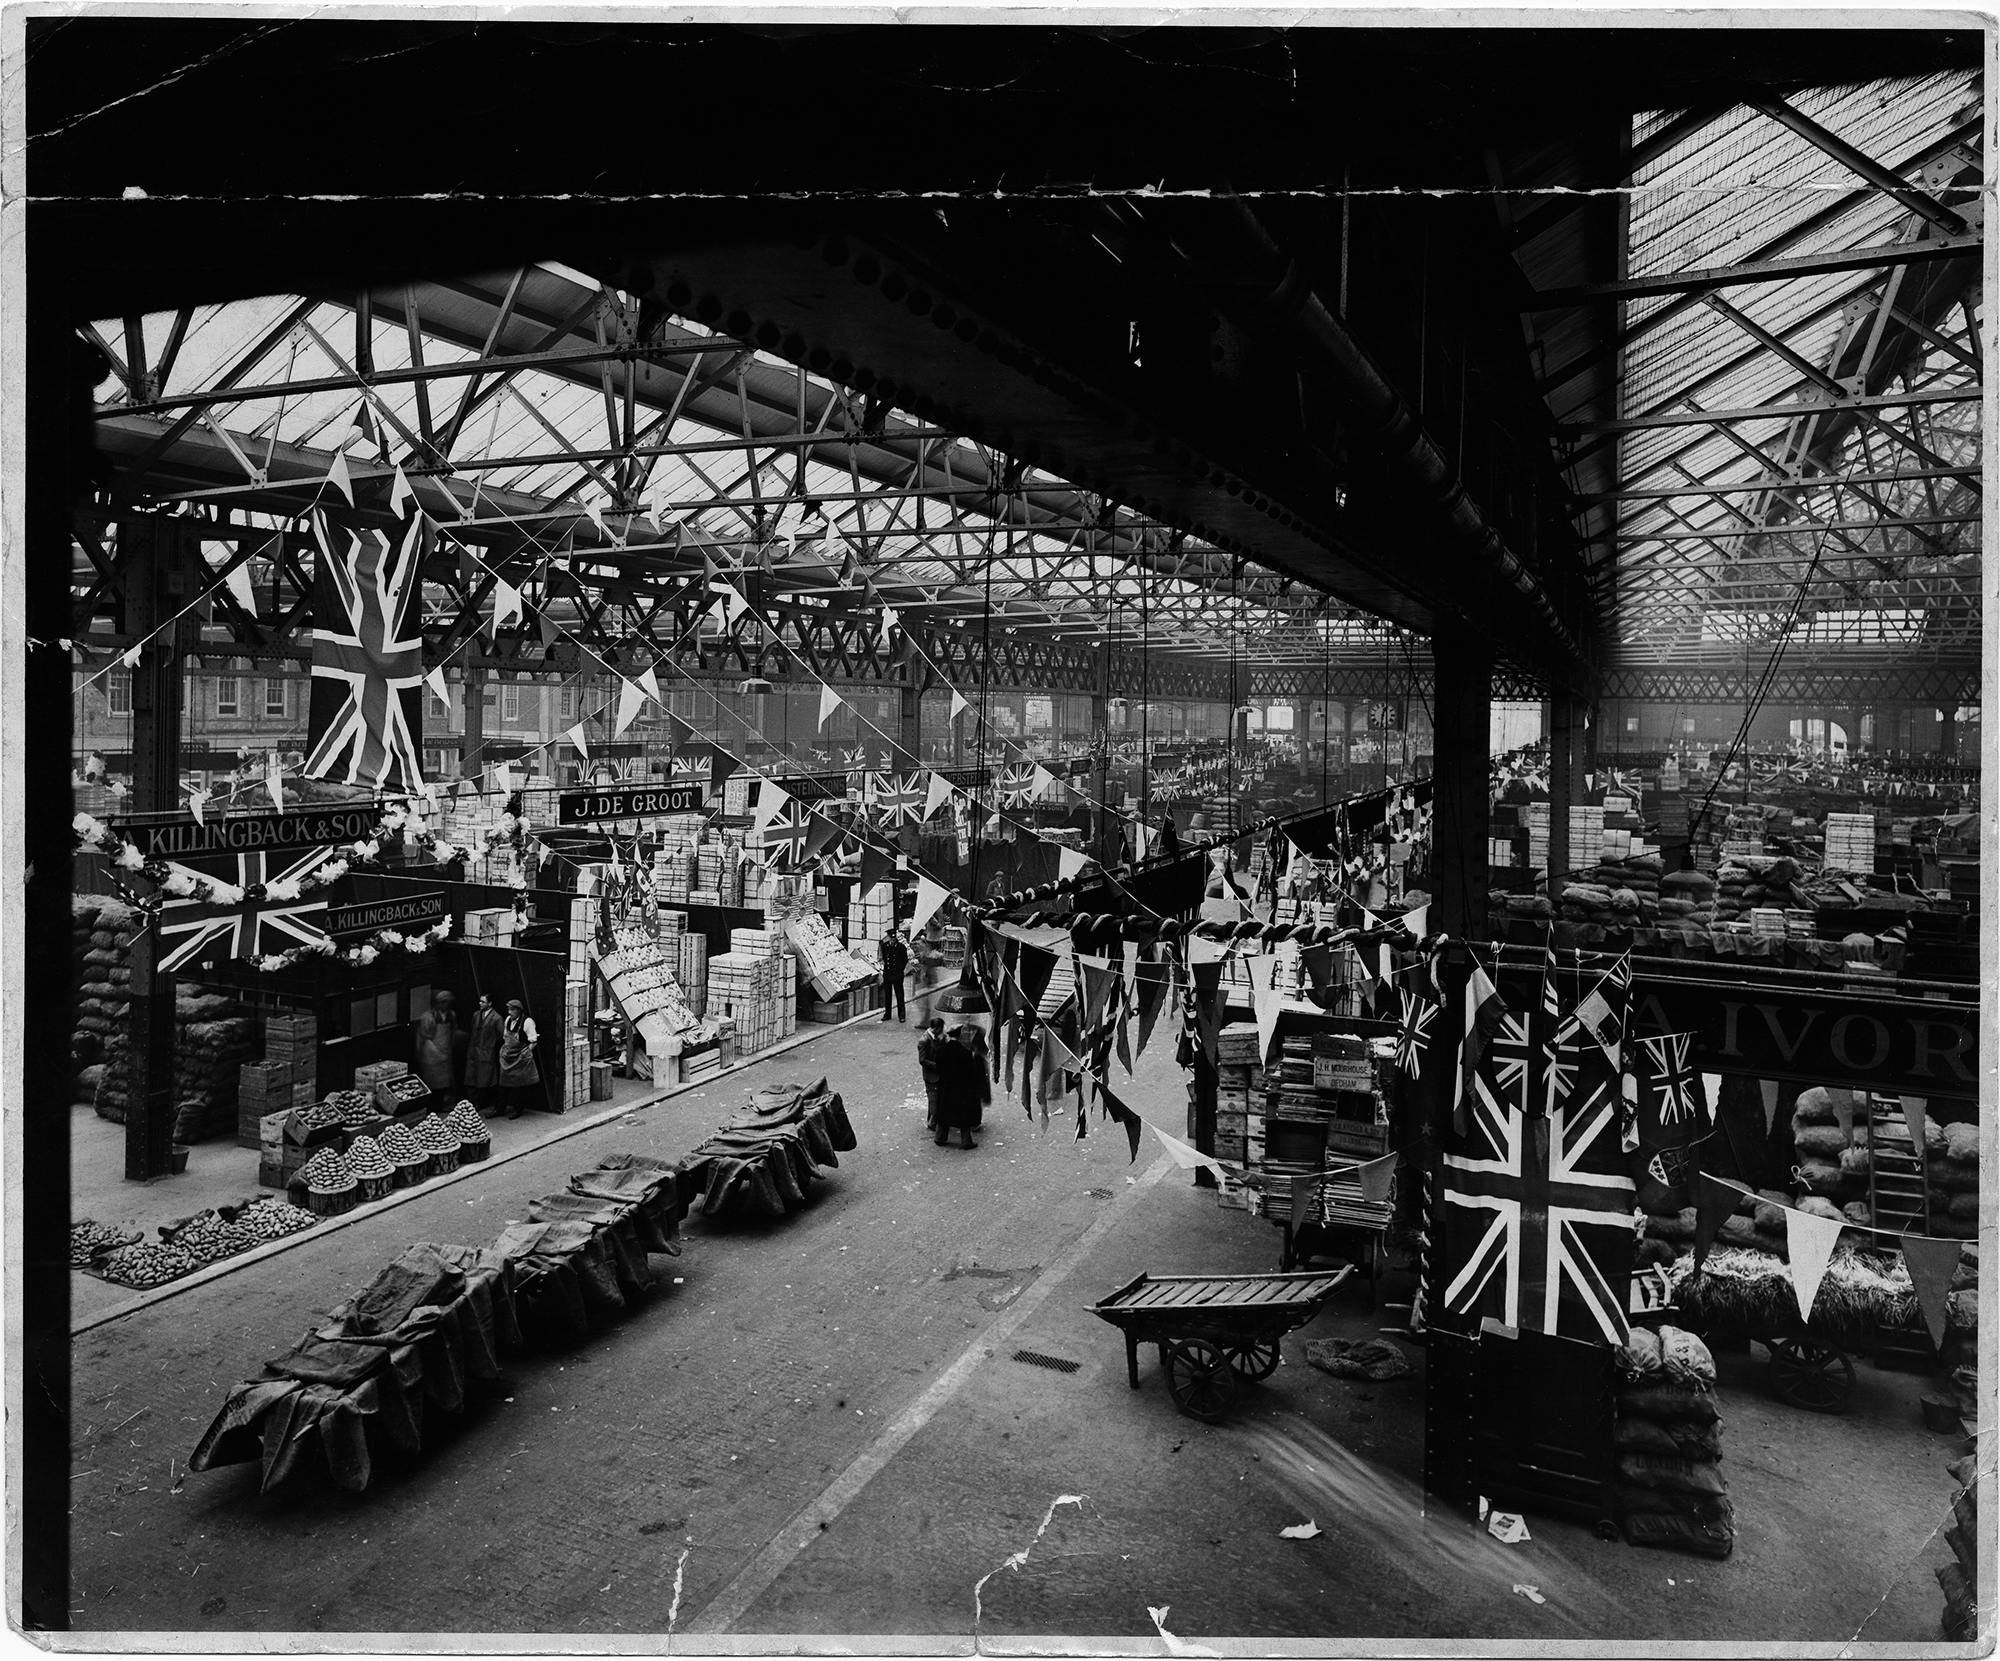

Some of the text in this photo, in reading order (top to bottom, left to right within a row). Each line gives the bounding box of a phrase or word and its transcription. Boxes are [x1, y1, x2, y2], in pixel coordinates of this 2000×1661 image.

[823, 779, 846, 793] SONS
[945, 773, 980, 785] WEBSTE
[632, 791, 693, 813] GROOT
[148, 816, 314, 855] KILLINGBACK
[338, 903, 417, 930] KILLINGBACK
